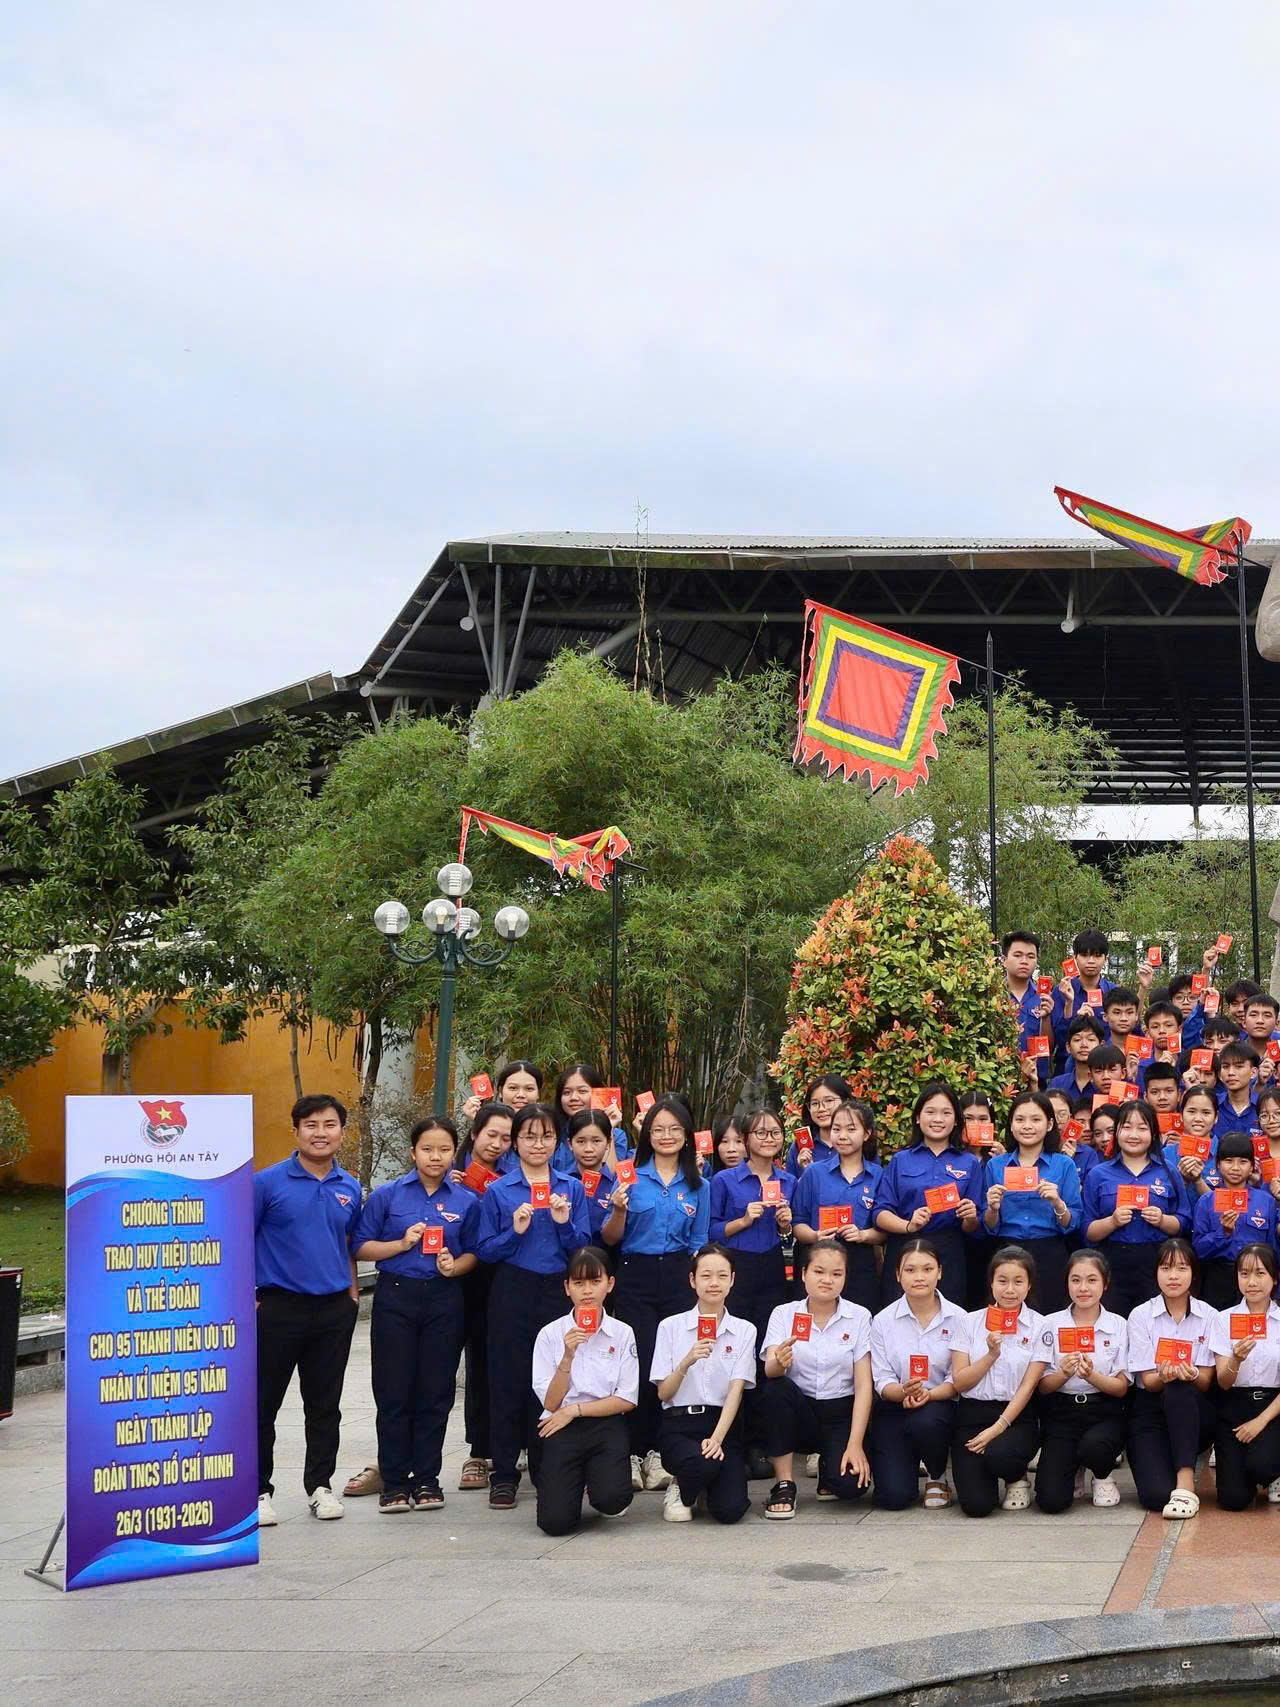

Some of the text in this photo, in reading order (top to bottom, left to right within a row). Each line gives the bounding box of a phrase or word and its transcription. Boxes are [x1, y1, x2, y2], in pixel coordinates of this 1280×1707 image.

[157, 1152, 176, 1163] HỘI
[180, 1153, 195, 1162] AN
[198, 1151, 219, 1161] TÂY
[122, 1195, 205, 1228] CHƯƠNG TRÌNH
[104, 1235, 221, 1273] TRAO HUY HIỆU ĐOÀN
[127, 1278, 200, 1313] VÀ THẺ ĐOÀN
[90, 1319, 236, 1360] CHO 95 THANH NIÊN ƯU TÚ
[100, 1362, 227, 1404] NHÂN KỈ NIỆM 95 NĂM
[116, 1407, 212, 1447] NGÀY THÀNH LẬP
[94, 1461, 127, 1493] ĐOÀN
[129, 1461, 160, 1489] TNCS
[181, 1450, 202, 1483] CHÍ
[203, 1454, 234, 1481] MINH
[116, 1500, 213, 1536] 26/3 (1931-2026)
